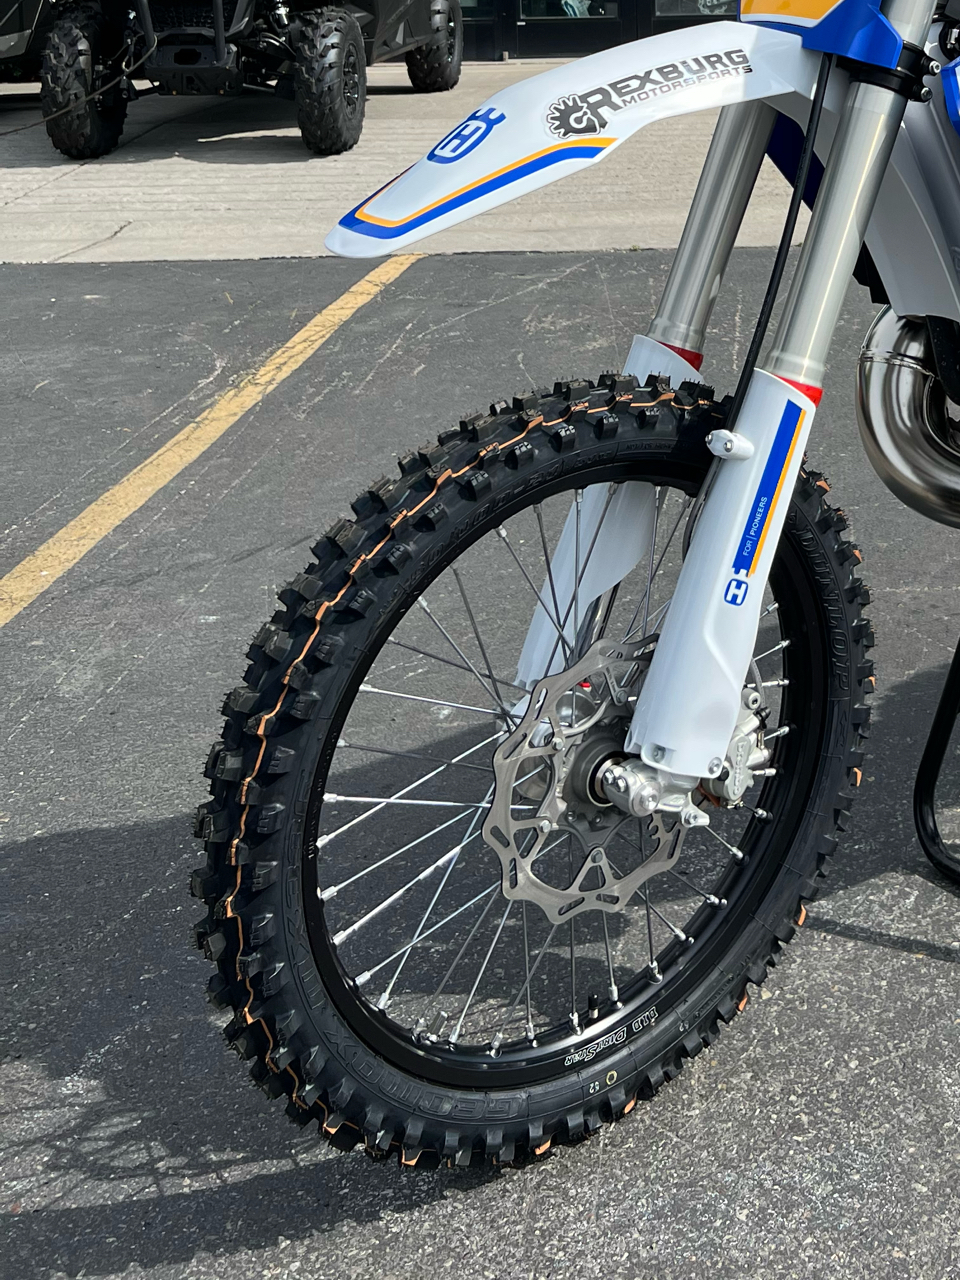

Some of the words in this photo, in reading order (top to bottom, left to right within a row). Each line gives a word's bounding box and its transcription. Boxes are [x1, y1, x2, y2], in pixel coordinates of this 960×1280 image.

[578, 48, 750, 130] REXBURG
[621, 64, 753, 108] MOTORSPORTS
[742, 540, 754, 556] FOR
[749, 496, 768, 536] PIONEERS
[800, 527, 850, 690] DUNLOP
